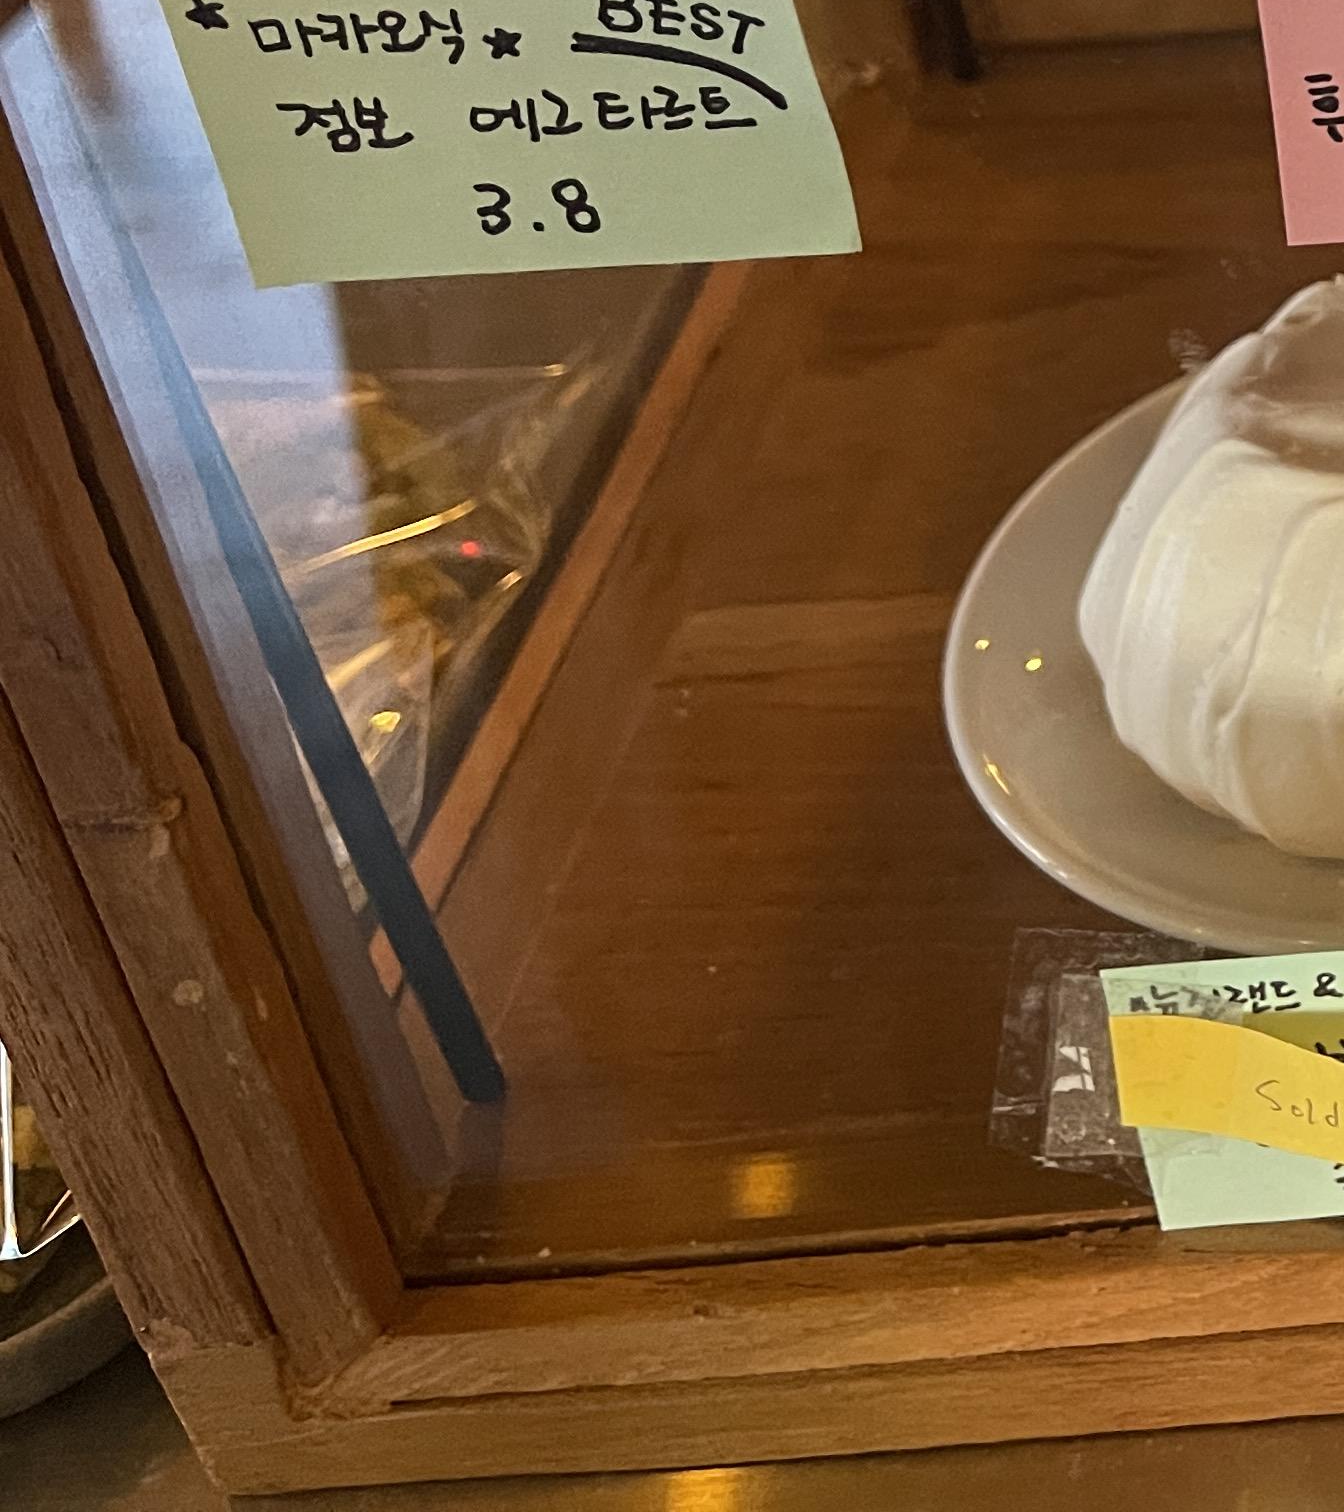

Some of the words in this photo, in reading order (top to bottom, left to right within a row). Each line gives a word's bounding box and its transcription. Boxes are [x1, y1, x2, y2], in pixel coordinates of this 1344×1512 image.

[250, 10, 466, 64] 마카오식
[277, 95, 414, 152] 점보
[473, 179, 601, 234] 3.8
[1313, 972, 1344, 998] &
[1256, 1079, 1339, 1128] Sold
